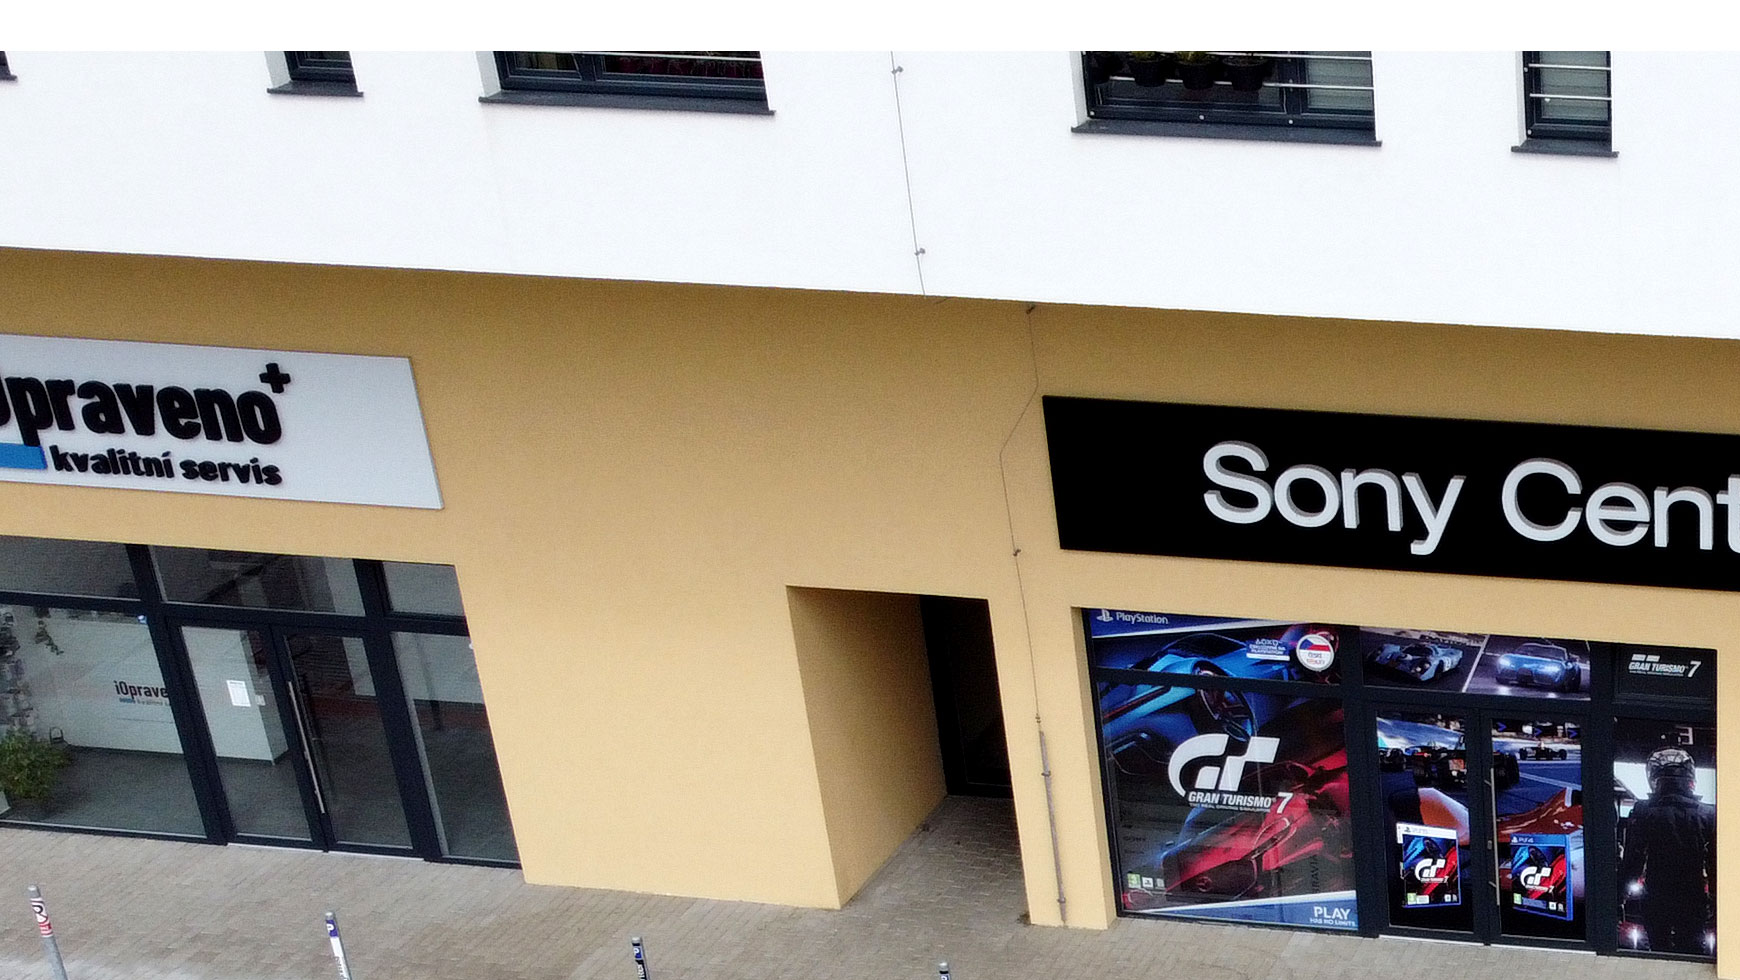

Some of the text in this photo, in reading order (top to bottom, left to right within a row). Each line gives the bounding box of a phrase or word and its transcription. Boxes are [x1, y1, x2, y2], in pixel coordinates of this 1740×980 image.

[50, 445, 283, 486] kvalitní servis
[1203, 441, 1466, 555] Sony
[1116, 612, 1169, 625] PlayStation
[1628, 661, 1650, 672] GRAN
[1651, 663, 1686, 674] TURISMO
[1687, 660, 1702, 678] 7
[1188, 791, 1294, 814] GRAN TURISMO 7
[1313, 906, 1351, 920] PLAY
